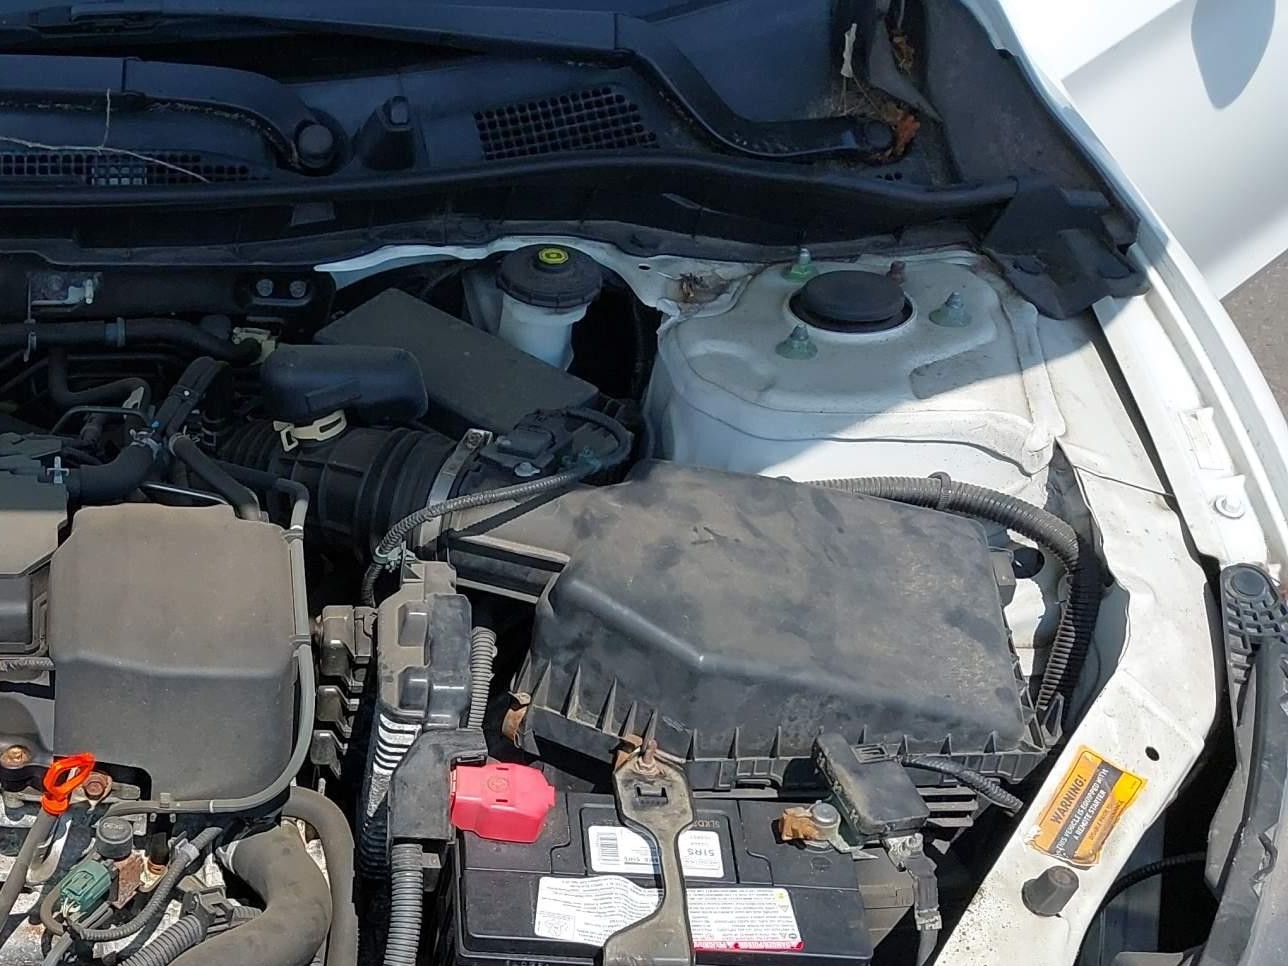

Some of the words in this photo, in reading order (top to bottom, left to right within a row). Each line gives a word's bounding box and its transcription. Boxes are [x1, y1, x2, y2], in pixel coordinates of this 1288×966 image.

[1049, 774, 1087, 825] WARNING!
[1062, 814, 1080, 837] VEHICLE
[1079, 782, 1099, 809] EQUIPPED
[1074, 812, 1092, 835] REMOTE
[1087, 789, 1106, 814] STARTER
[688, 848, 715, 857] 51RS
